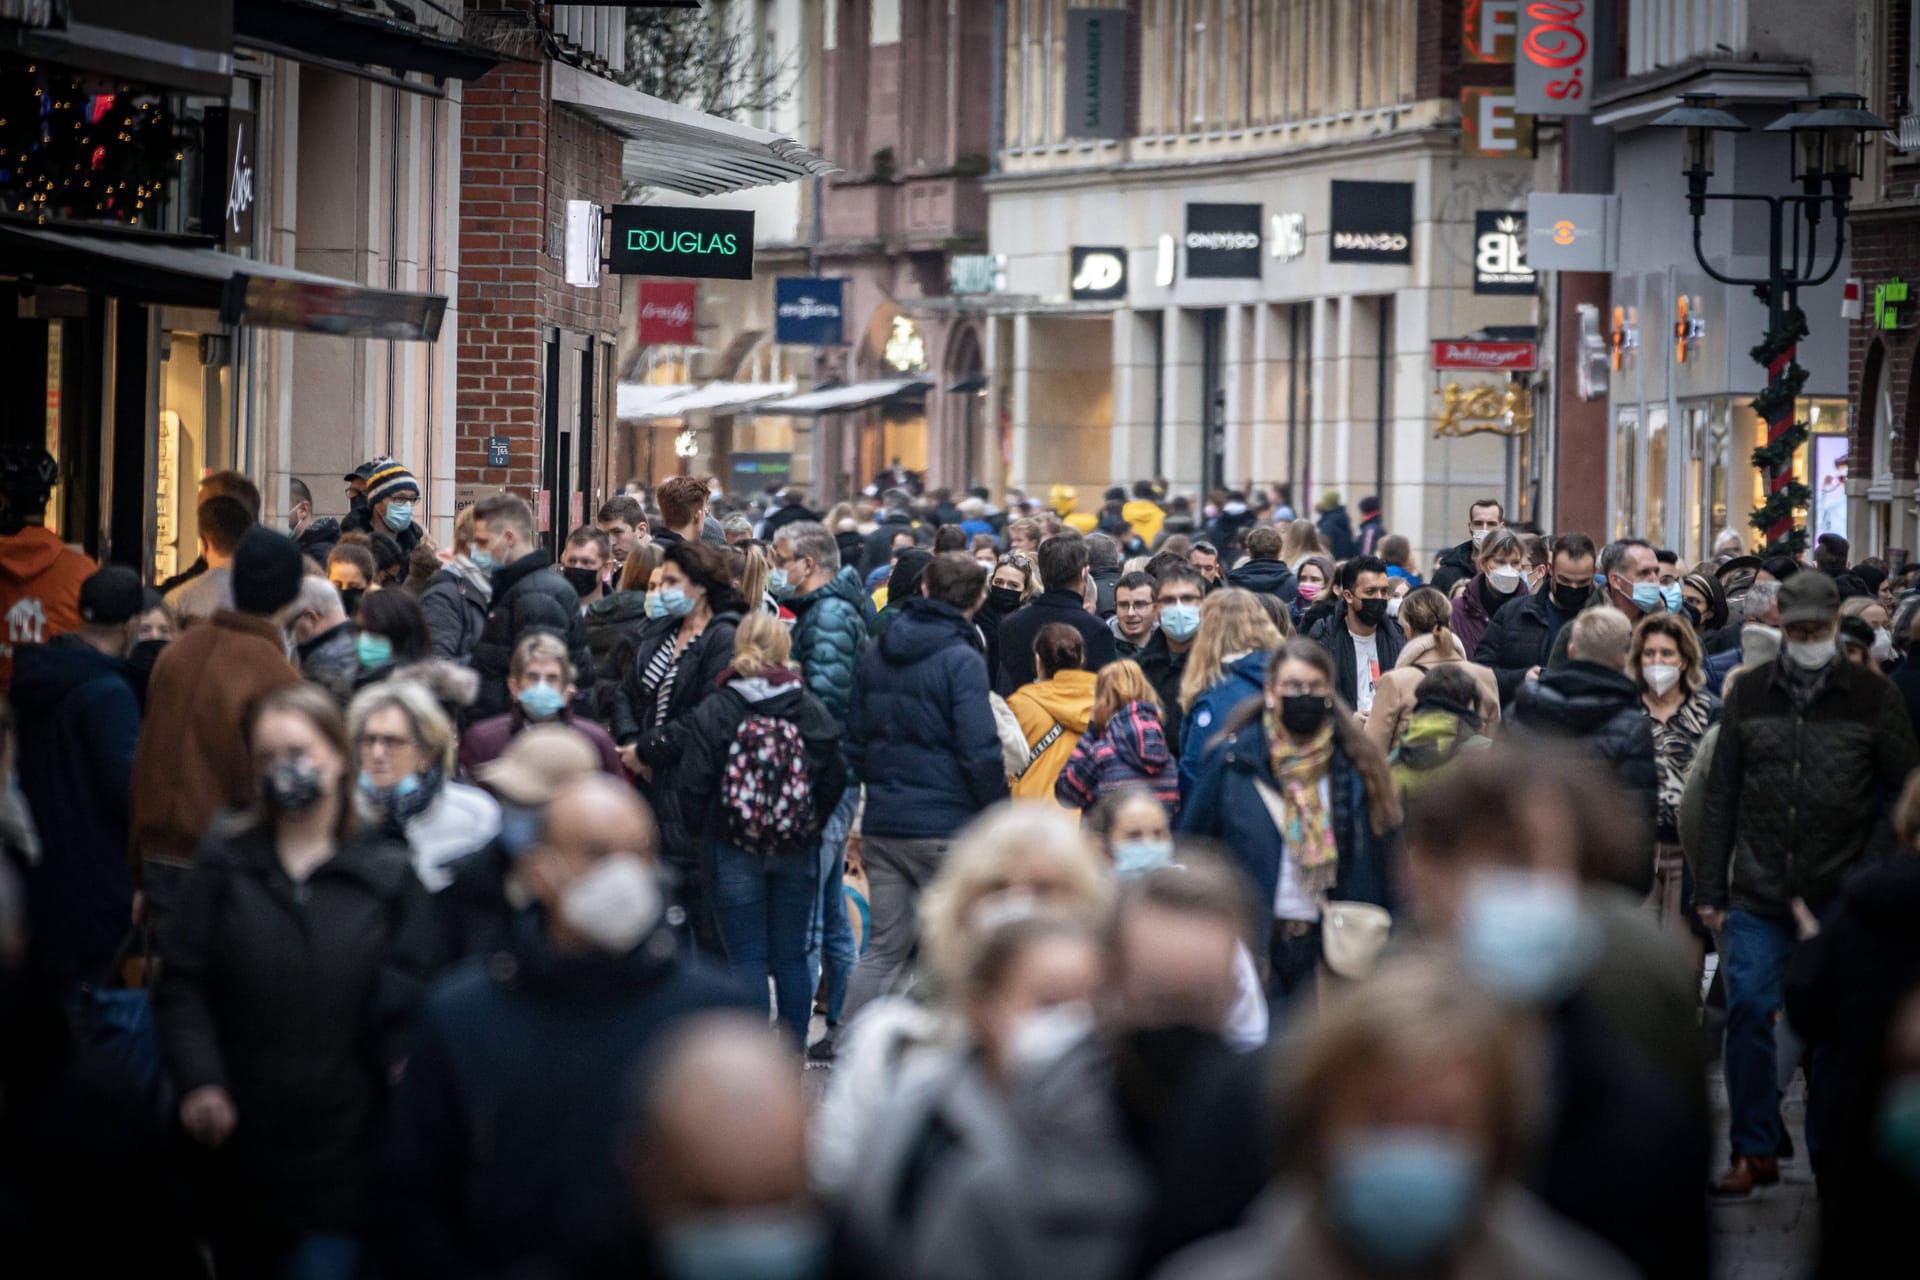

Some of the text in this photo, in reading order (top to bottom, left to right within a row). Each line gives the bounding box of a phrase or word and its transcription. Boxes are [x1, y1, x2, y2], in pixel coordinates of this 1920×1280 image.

[1522, 0, 1587, 100] s.Ol
[627, 230, 737, 255] DOUGLAS
[1334, 233, 1408, 251] MANGO
[1073, 253, 1122, 289] JD
